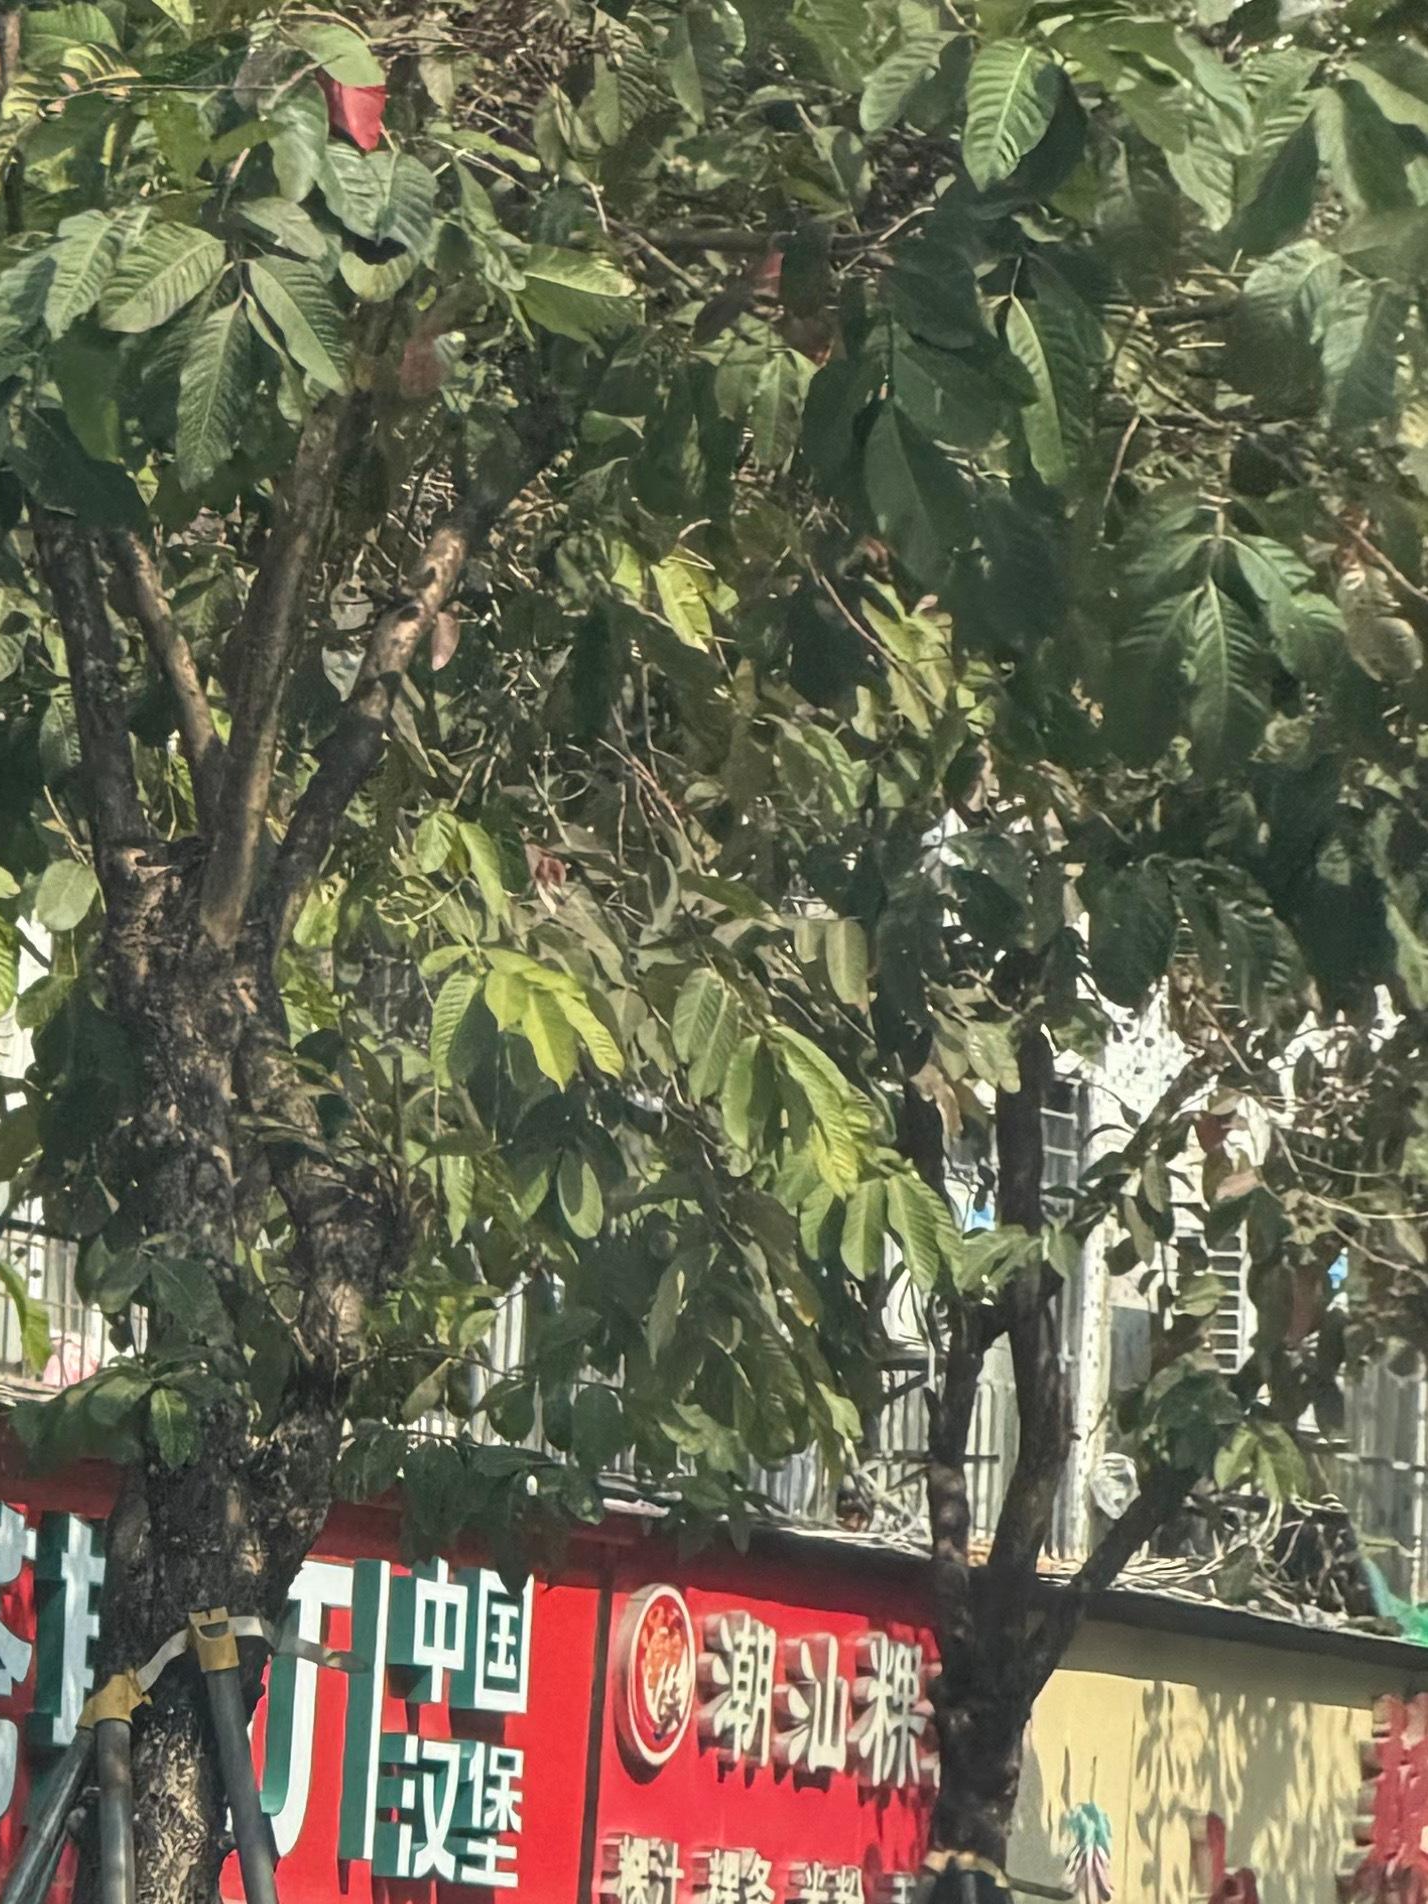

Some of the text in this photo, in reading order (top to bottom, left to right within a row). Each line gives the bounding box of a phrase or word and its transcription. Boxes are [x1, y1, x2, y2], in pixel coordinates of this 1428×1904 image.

[413, 1556, 534, 1714] 中国
[710, 1608, 942, 1790] 潮汕粿
[396, 1734, 524, 1888] 汉堡
